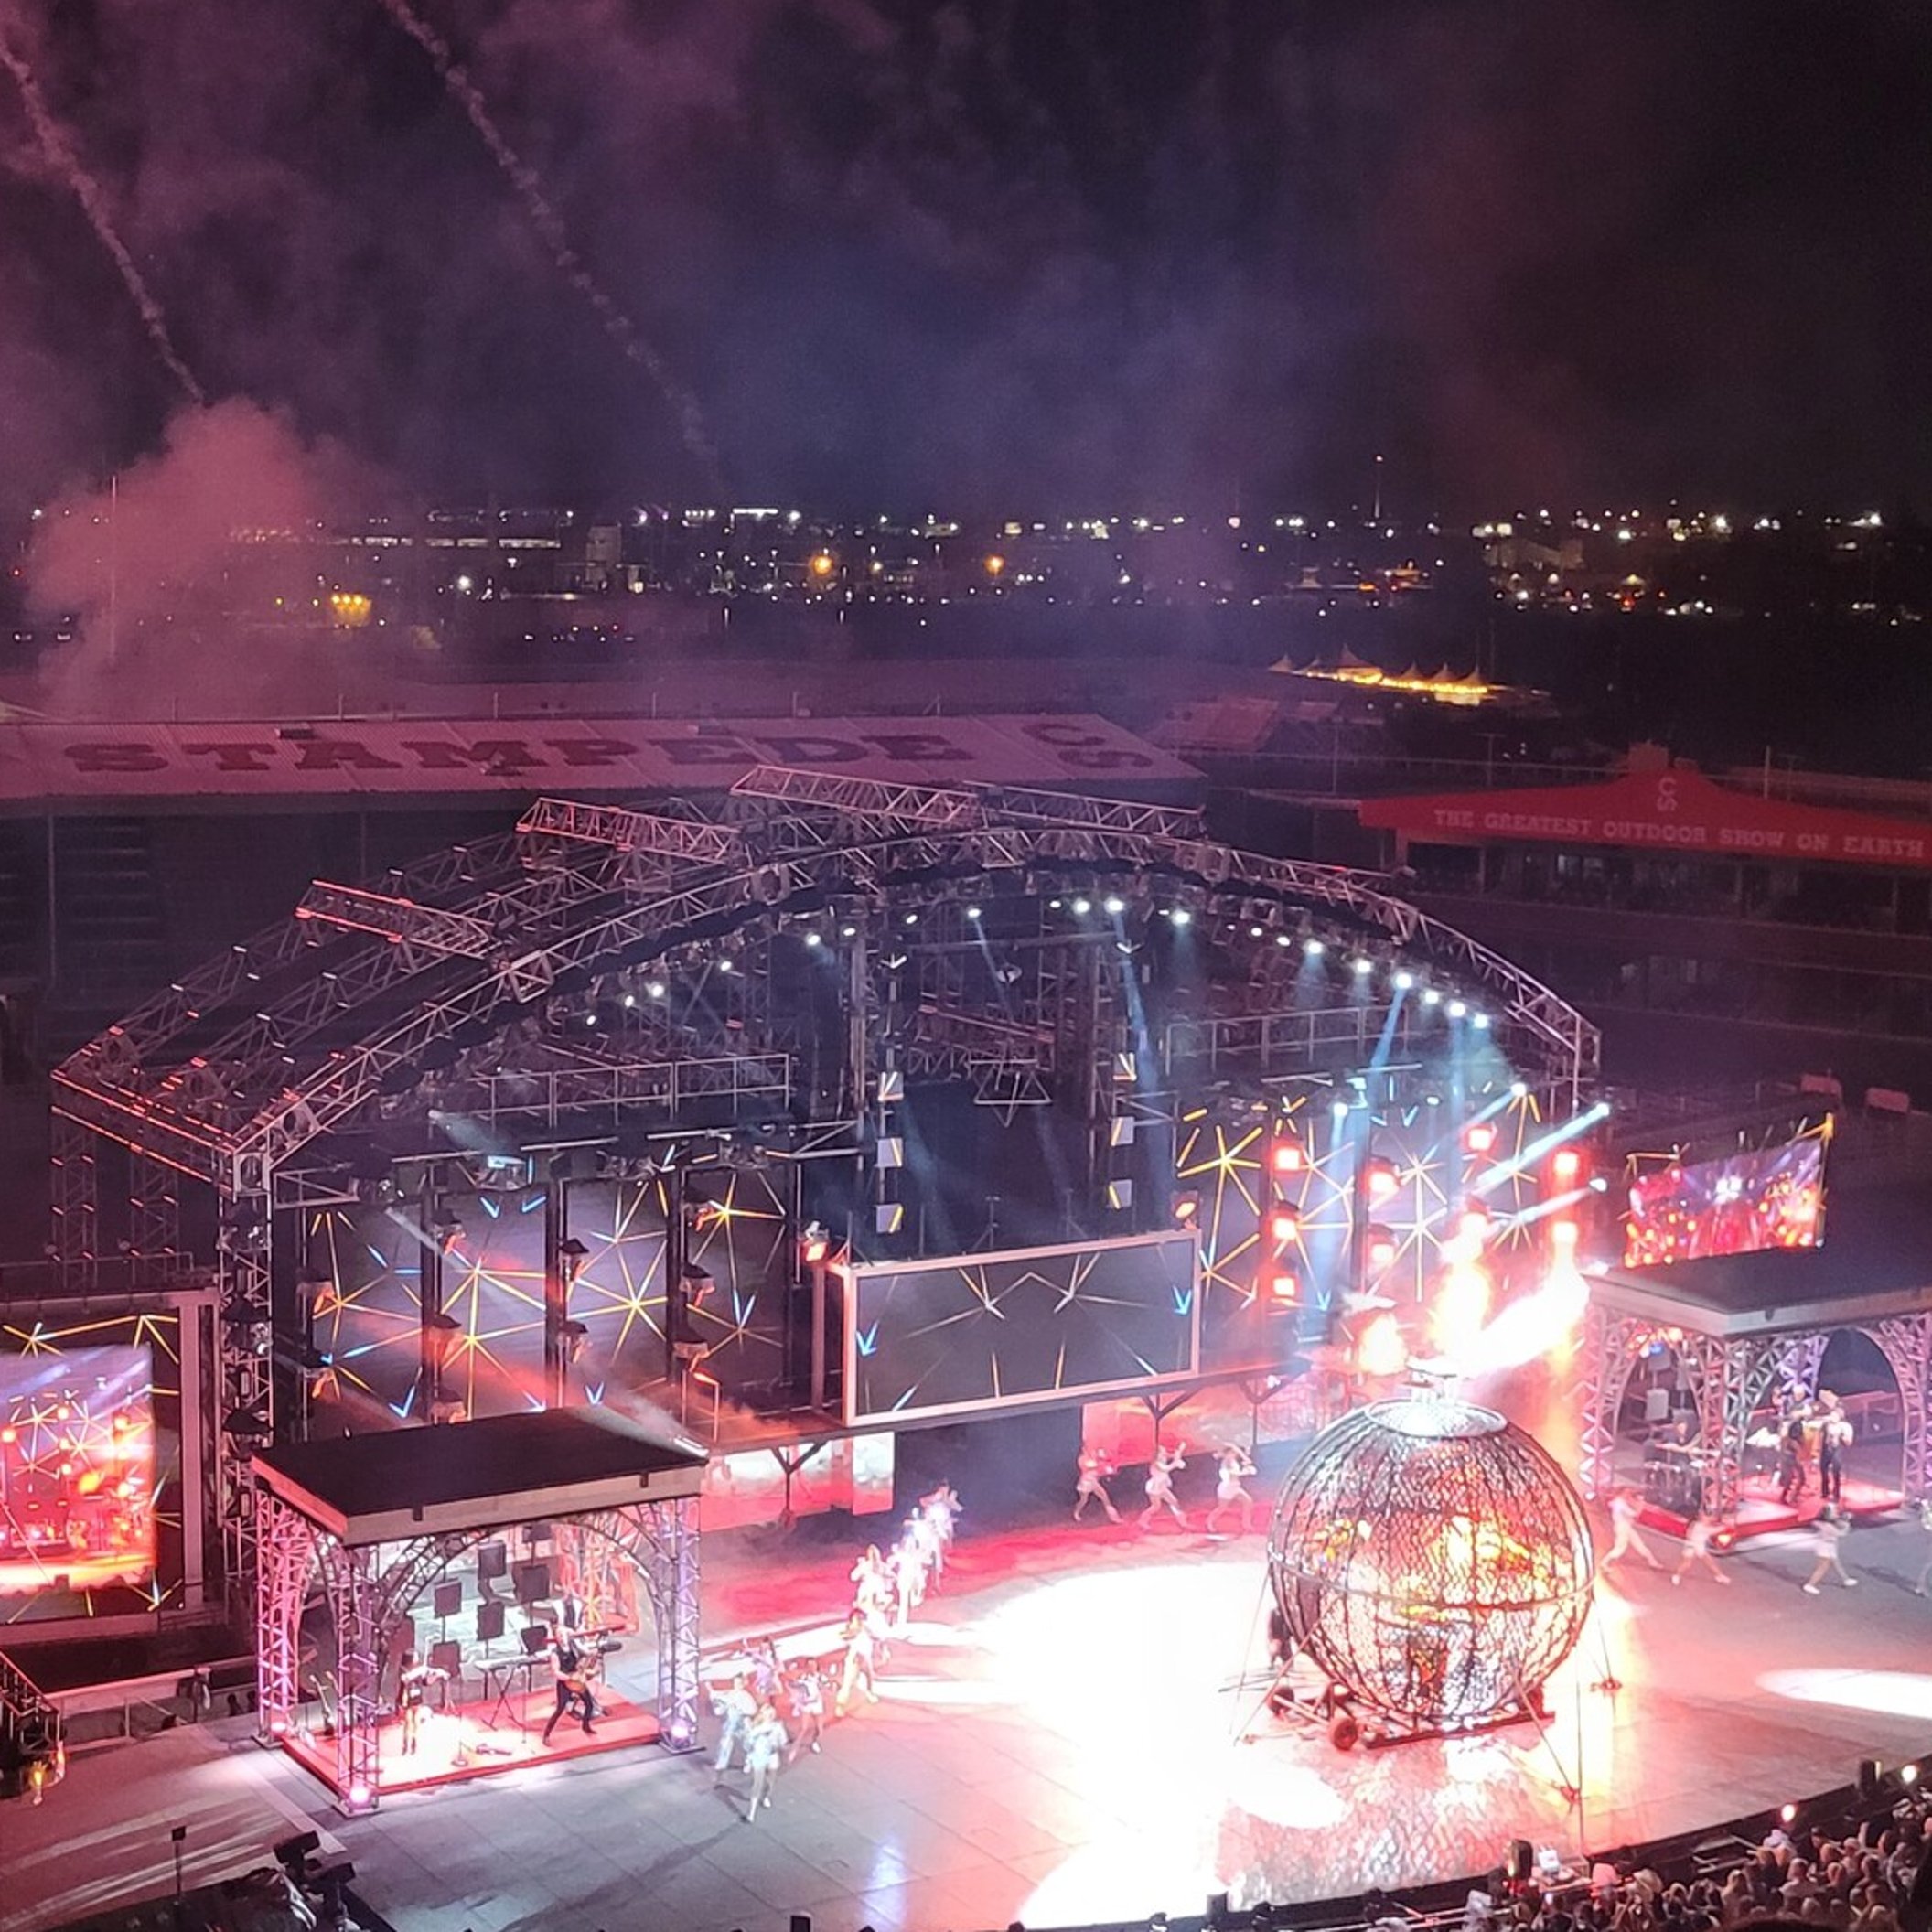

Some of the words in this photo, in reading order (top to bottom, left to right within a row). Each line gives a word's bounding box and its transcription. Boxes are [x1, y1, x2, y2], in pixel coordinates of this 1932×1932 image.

[64, 735, 974, 773] STAMPEDE
[1433, 810, 1475, 830] THE
[1483, 812, 1592, 837] GREATEST
[1602, 821, 1707, 843] OUTDOOR
[1719, 827, 1785, 849] SHOW
[1795, 833, 1830, 852] ON
[1842, 836, 1925, 858] EARTH
